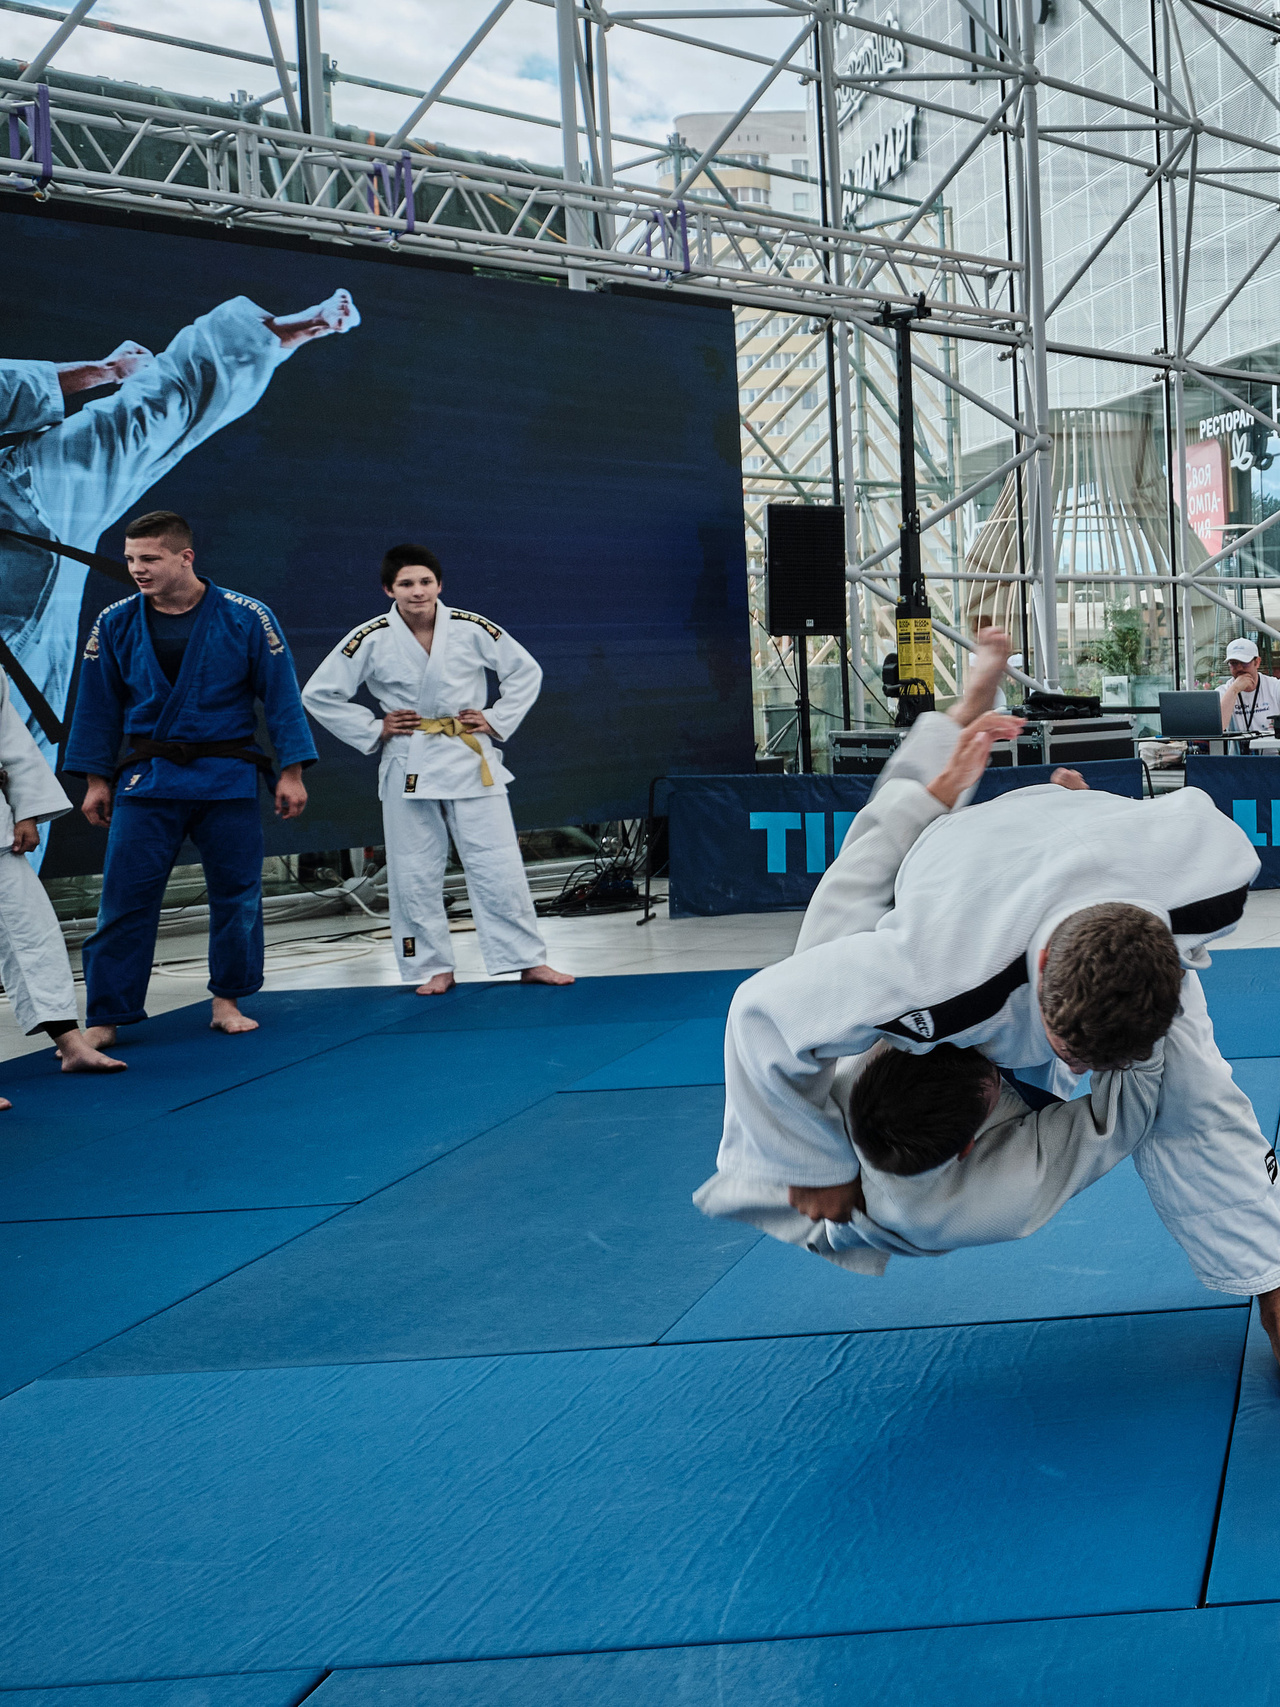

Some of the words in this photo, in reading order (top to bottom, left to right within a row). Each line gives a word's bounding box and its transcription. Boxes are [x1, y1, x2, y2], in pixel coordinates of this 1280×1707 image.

[839, 104, 917, 222] АЛАМАРТ
[1187, 490, 1221, 520] ОМПА-
[224, 592, 273, 631] MATSURU
